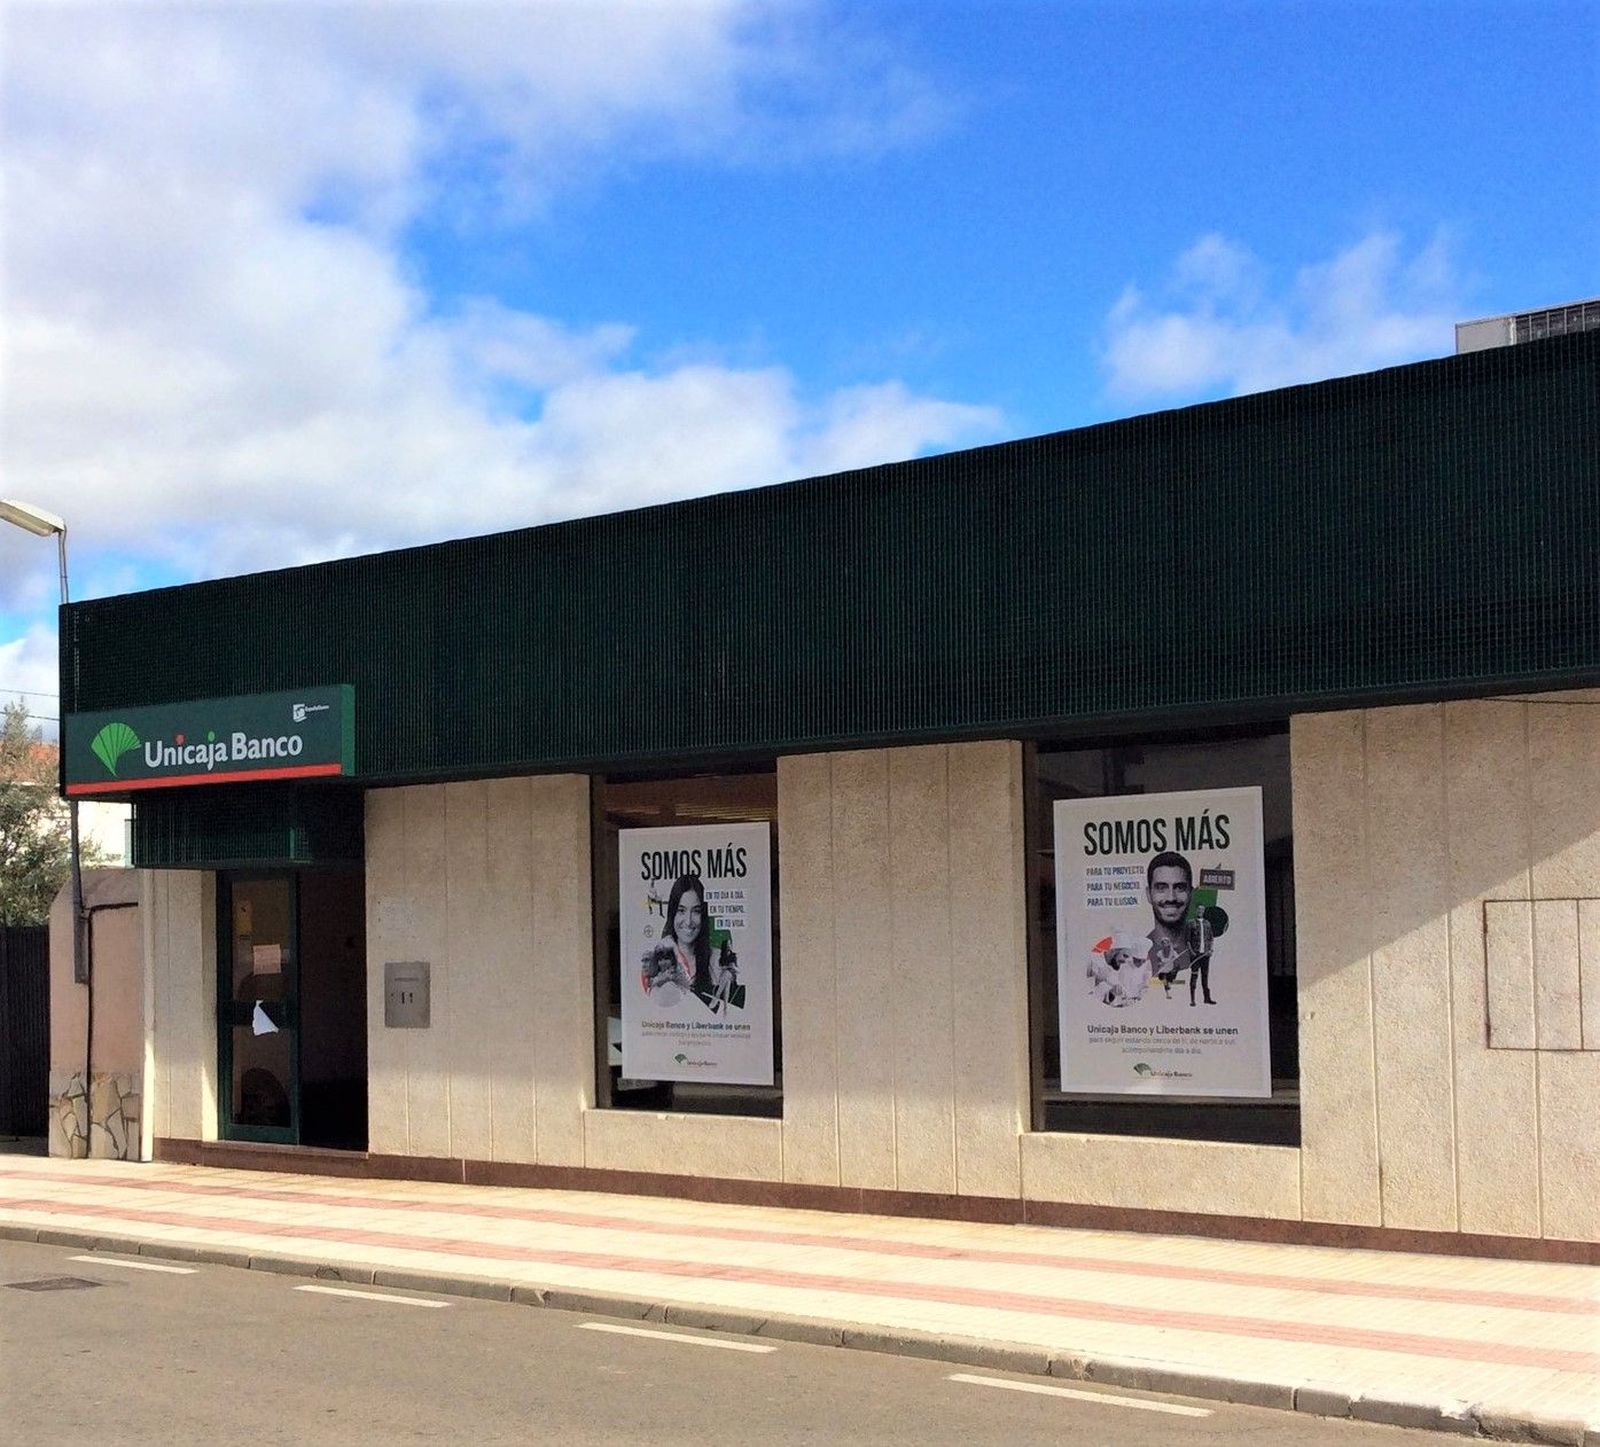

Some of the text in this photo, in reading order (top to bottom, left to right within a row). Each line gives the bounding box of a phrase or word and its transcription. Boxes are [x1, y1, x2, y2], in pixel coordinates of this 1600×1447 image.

[145, 731, 303, 771] Unicaja Banco
[1084, 809, 1230, 856] SOMOS MÁS
[641, 842, 748, 880] SOMOS MÁS
[1087, 867, 1103, 876] PARA
[1104, 867, 1112, 876] TU
[1087, 882, 1103, 891] PARA
[1105, 882, 1112, 891] TU
[1087, 898, 1103, 906] PARA
[1104, 897, 1113, 906] TU
[641, 1020, 665, 1031] Unicaja
[666, 1021, 686, 1030] Banco
[692, 1021, 724, 1030] Liberbank
[1087, 1024, 1239, 1036] Unicaja Banco y Liberbank se unen
